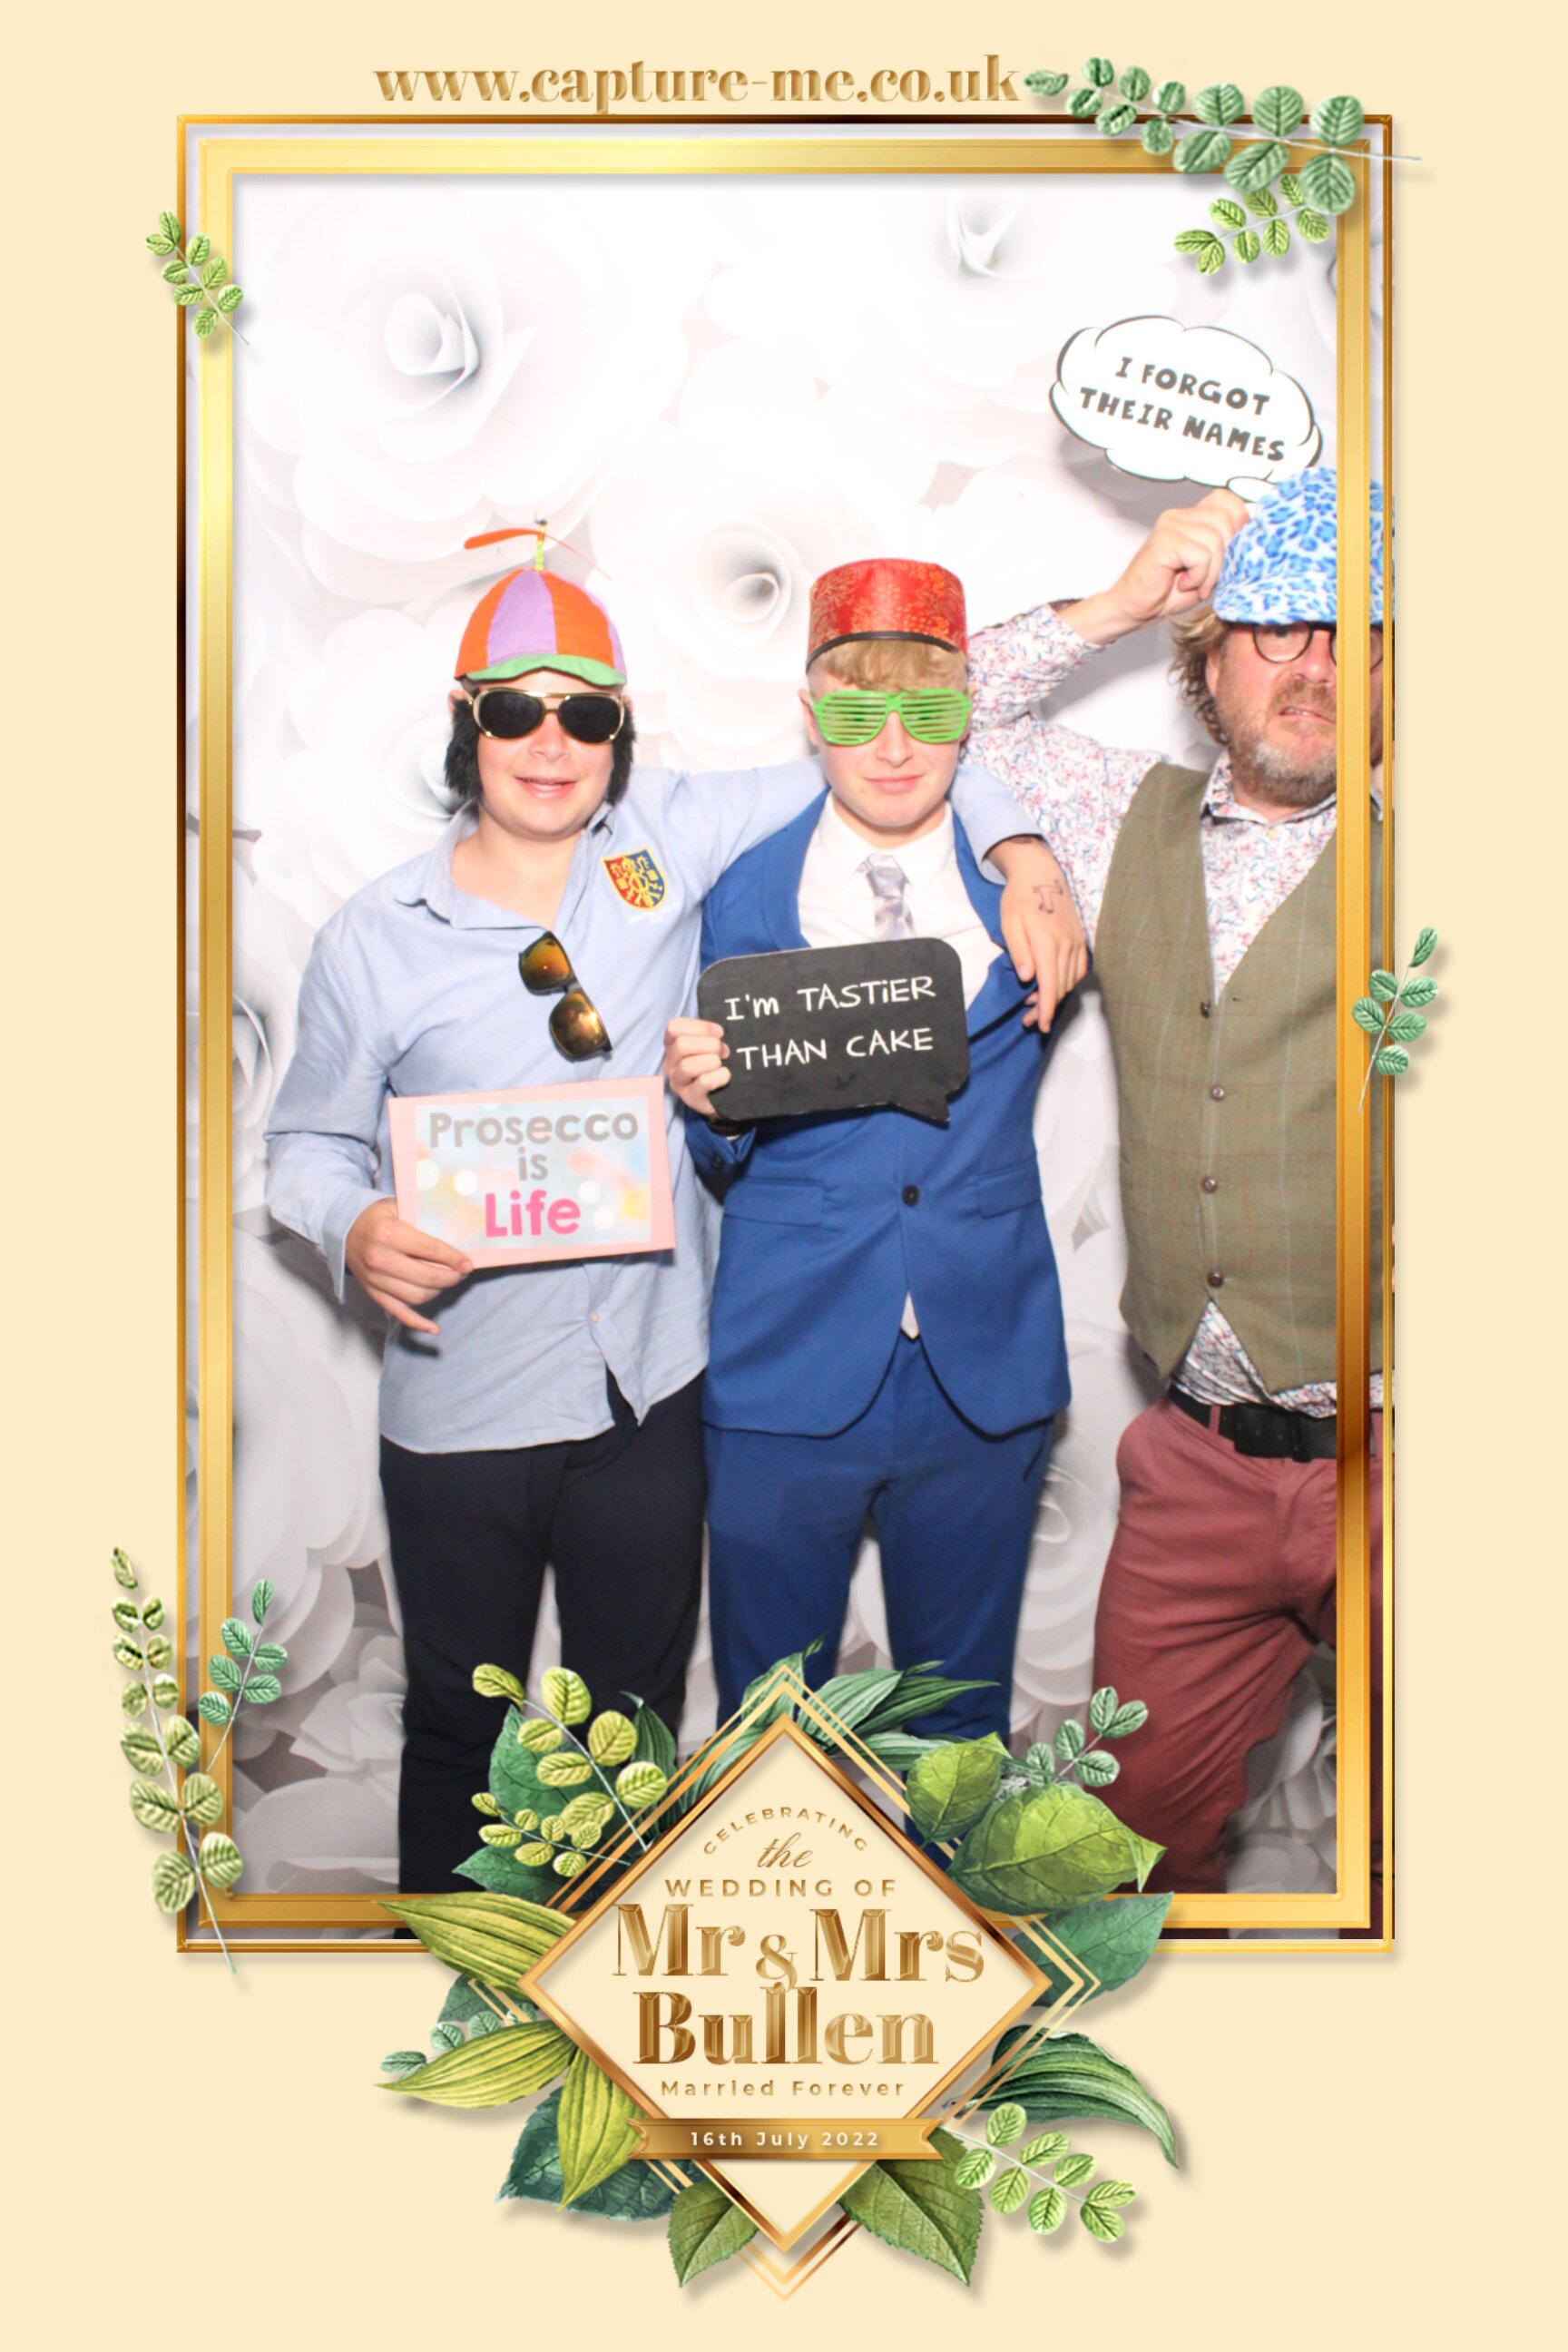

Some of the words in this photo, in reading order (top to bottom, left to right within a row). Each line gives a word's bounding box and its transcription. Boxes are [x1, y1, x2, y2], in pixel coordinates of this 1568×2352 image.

[1115, 357, 1132, 378] I
[1142, 364, 1270, 416] FORGOT
[1080, 387, 1172, 430] THEIR
[1182, 415, 1285, 462] NAMES
[736, 1039, 828, 1070] THAN
[846, 1027, 934, 1057] CAKE
[429, 1112, 639, 1148] Prosecco
[518, 1146, 549, 1181] is
[485, 1190, 582, 1239] Life
